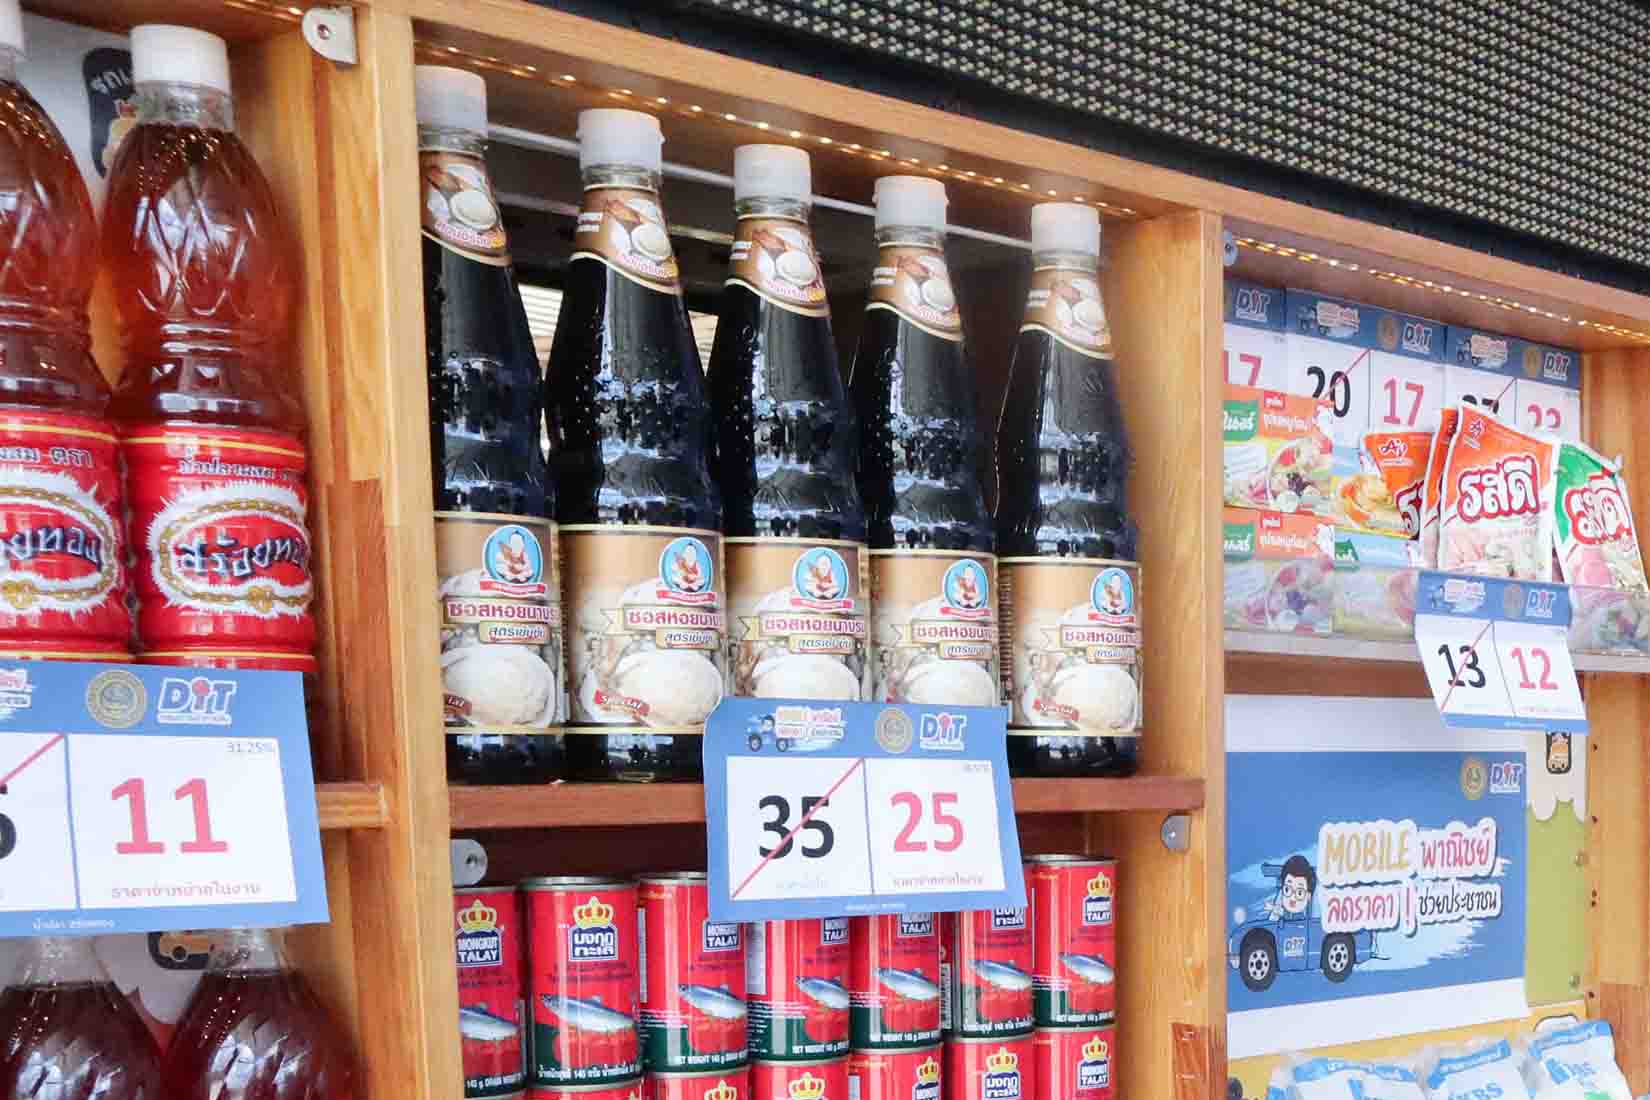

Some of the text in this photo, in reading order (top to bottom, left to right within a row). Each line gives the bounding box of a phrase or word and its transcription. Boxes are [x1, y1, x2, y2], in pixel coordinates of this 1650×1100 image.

[1383, 377, 1425, 427] 17
[1458, 455, 1541, 524] รสดี
[1437, 644, 1559, 691] 13 12
[111, 777, 229, 855] 11
[758, 790, 964, 860] 35 25
[1323, 830, 1411, 876] MOBILE
[1421, 824, 1492, 873] พาณิชย์
[1327, 890, 1395, 923] ลดราคา
[1418, 885, 1498, 918] ช่วยประชาชน
[457, 950, 498, 963] TALAY
[706, 936, 738, 948] TALAY
